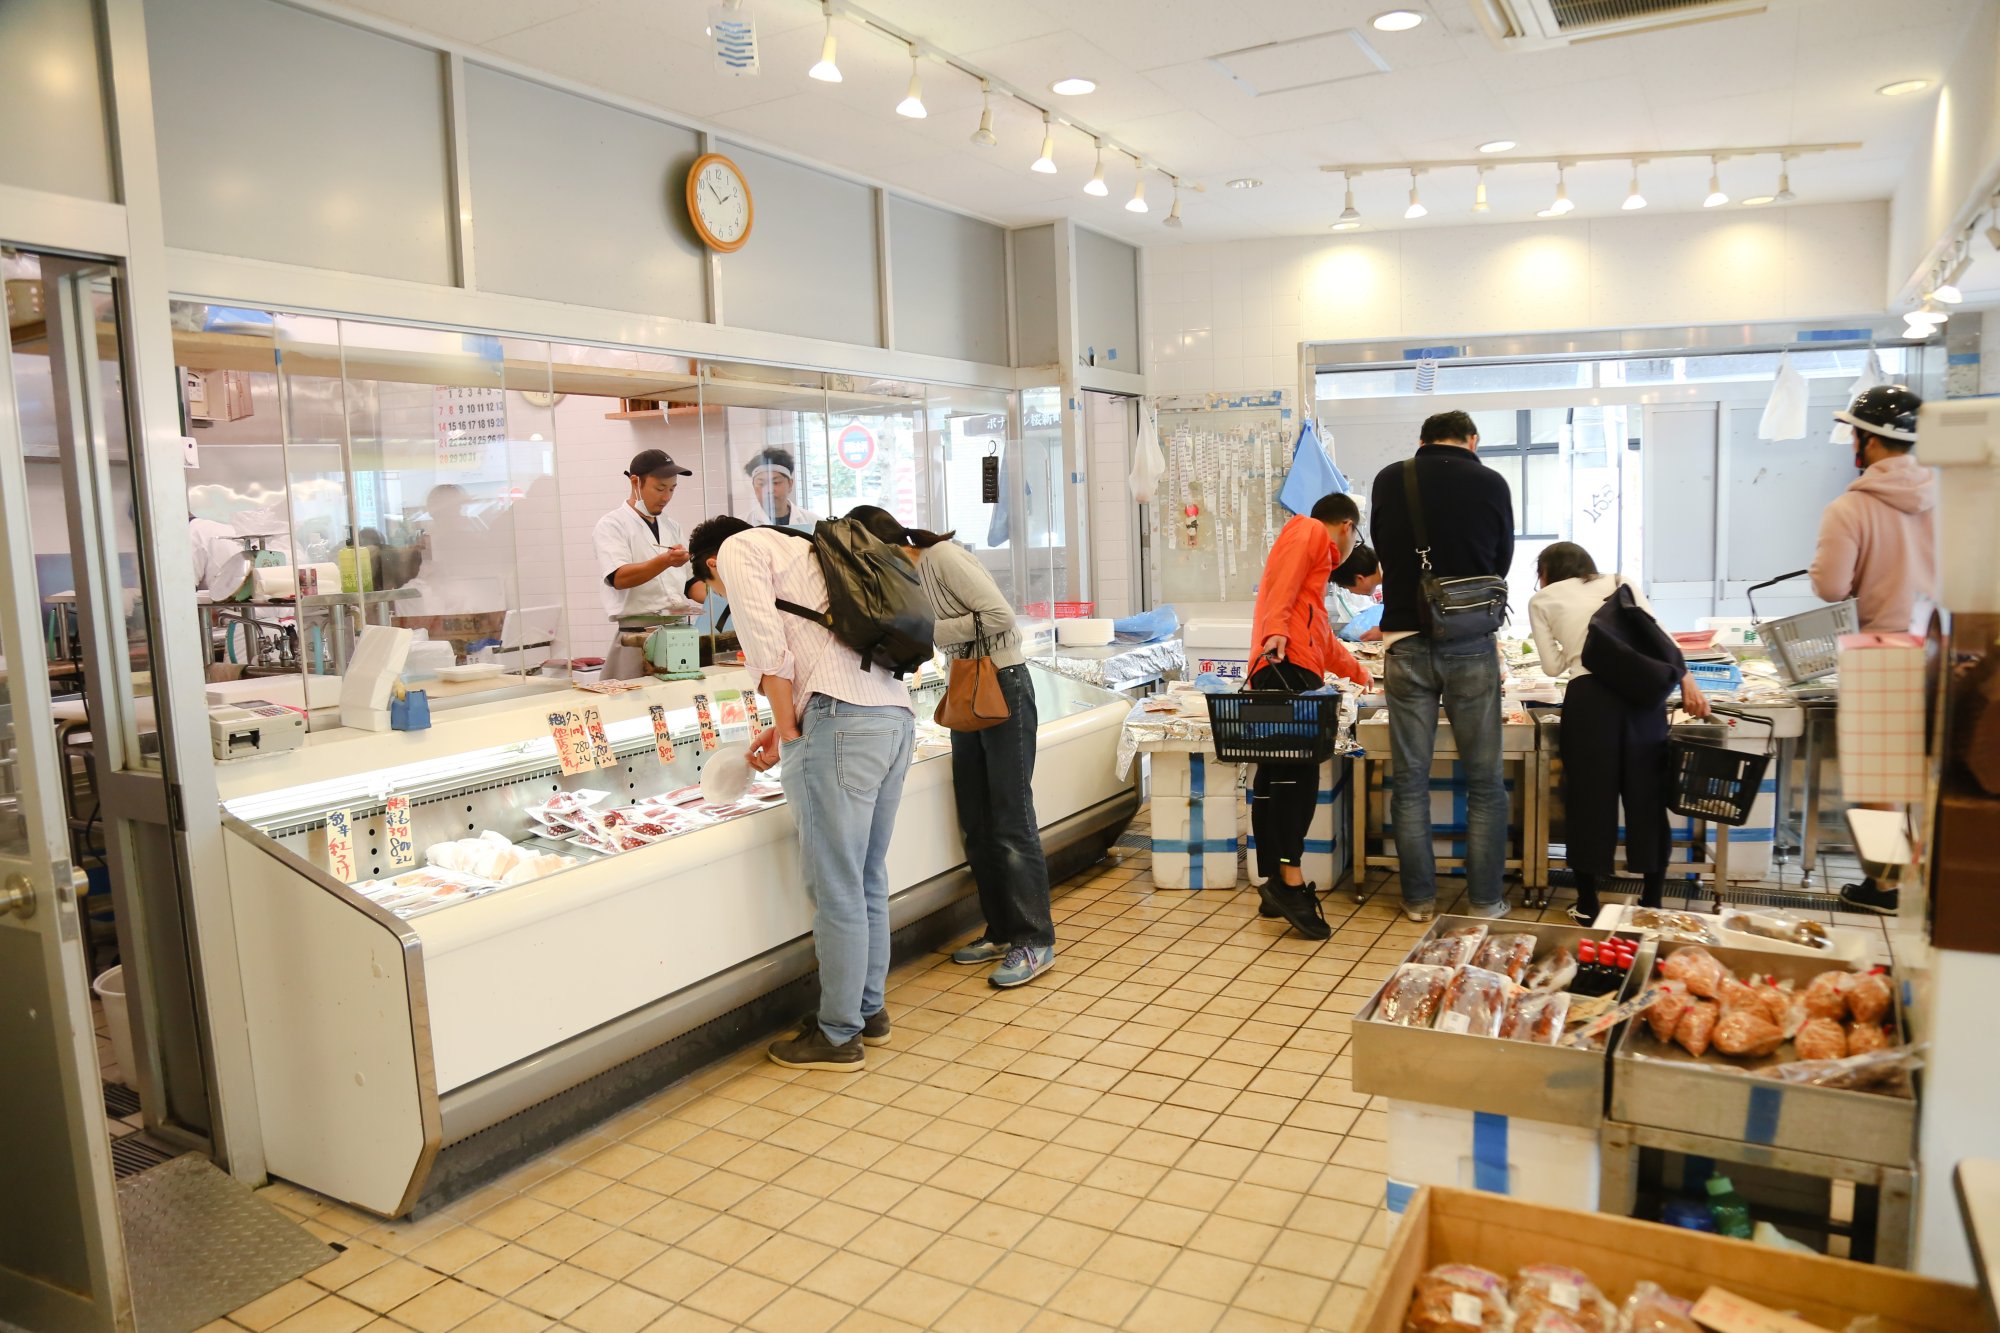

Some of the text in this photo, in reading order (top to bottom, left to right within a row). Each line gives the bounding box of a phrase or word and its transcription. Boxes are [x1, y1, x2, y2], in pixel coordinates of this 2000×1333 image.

[706, 169, 712, 180] 11
[715, 169, 722, 180] 12
[733, 186, 738, 198] 2
[735, 217, 739, 228] 4
[719, 228, 724, 238] 6
[728, 226, 733, 236] 5
[449, 390, 452, 398] 1
[459, 390, 462, 398] 2
[468, 389, 472, 397] 3
[439, 402, 504, 415] 7 8 9 10 11 12 13
[439, 418, 504, 432] 14 15 16 17 18 19 20
[439, 434, 505, 448] 21 22 23 24 25 26 27
[573, 741, 589, 753] 280
